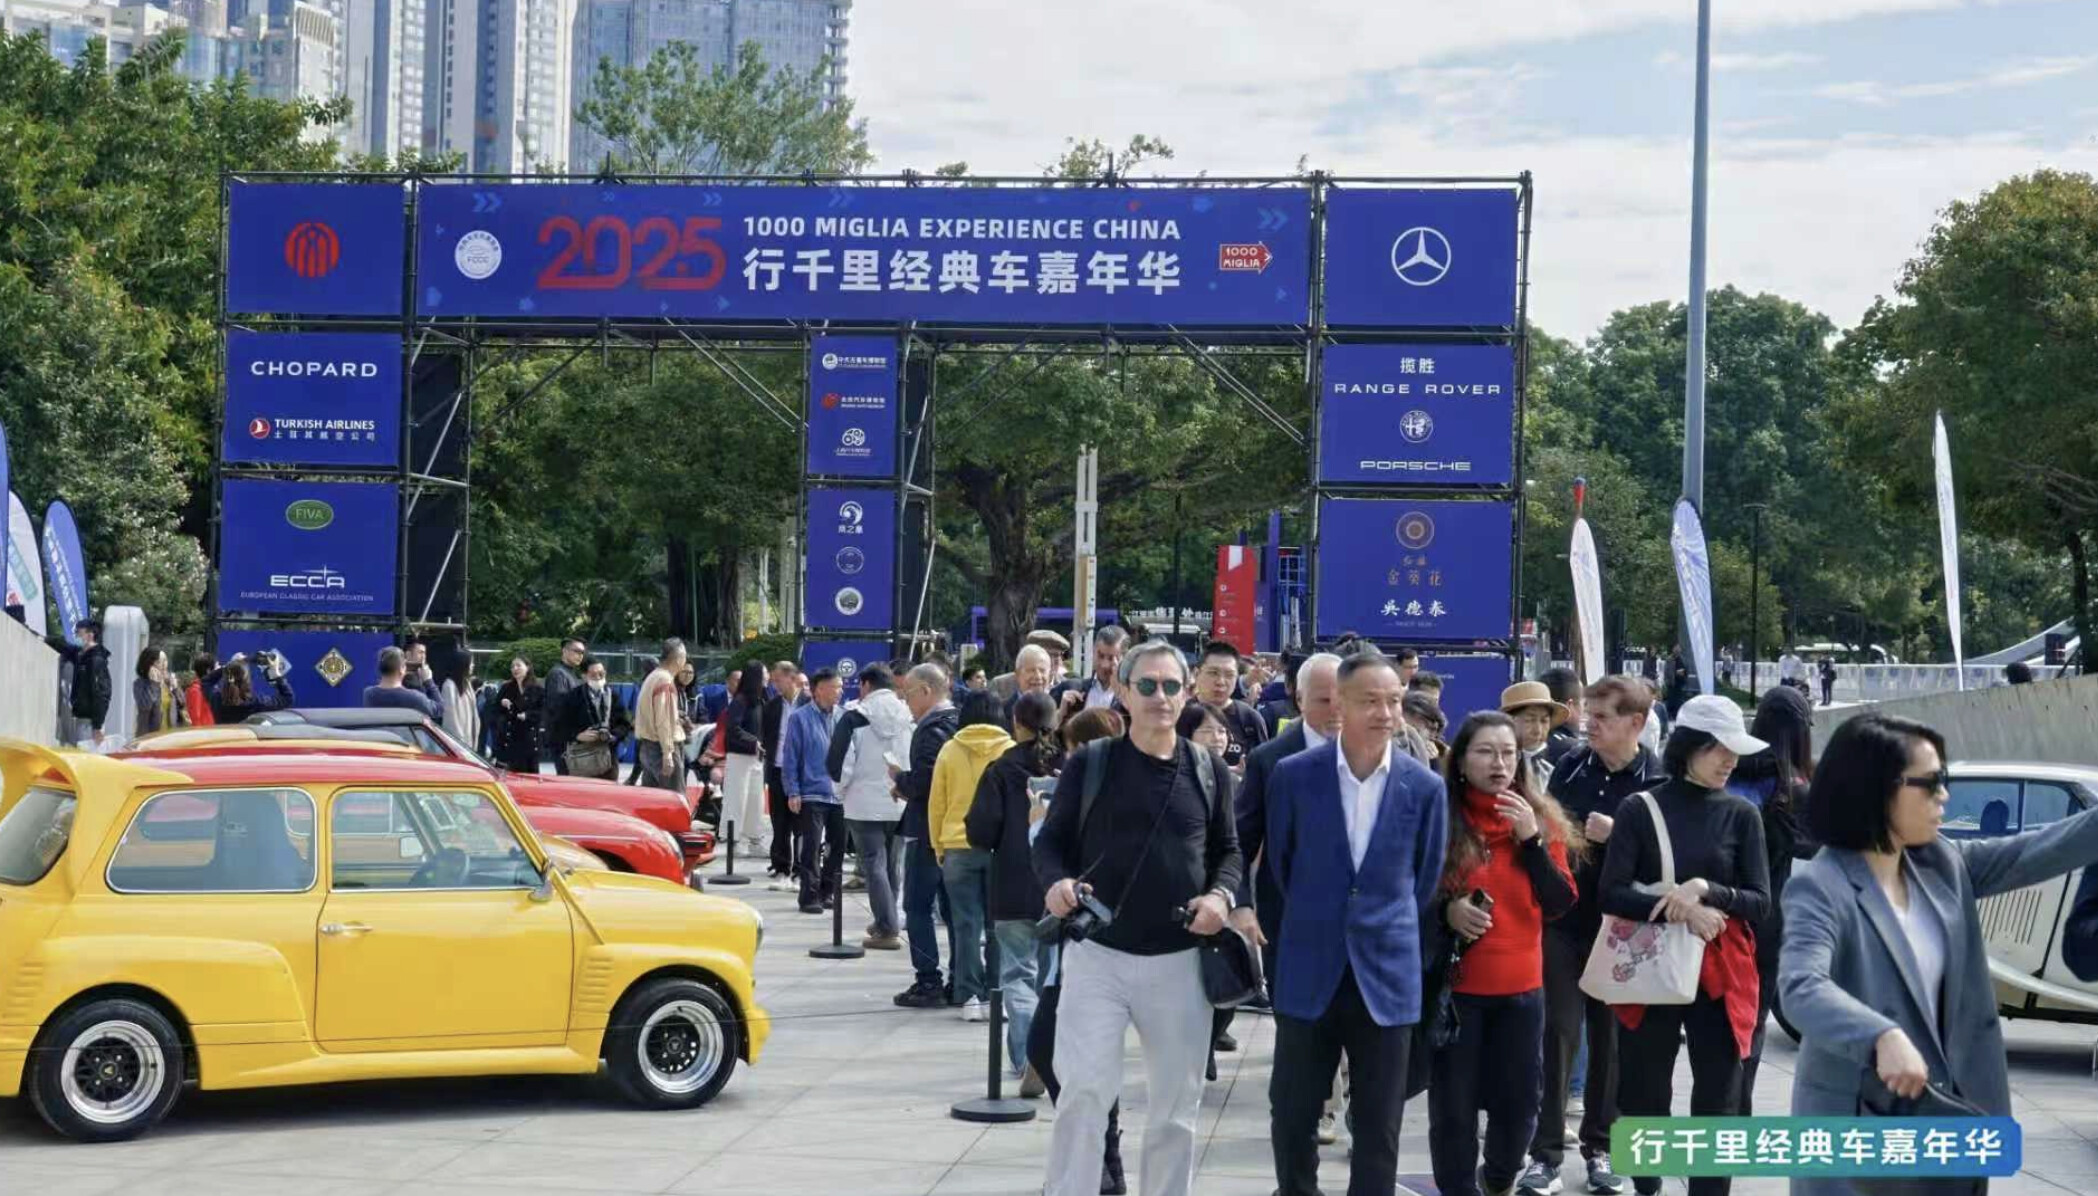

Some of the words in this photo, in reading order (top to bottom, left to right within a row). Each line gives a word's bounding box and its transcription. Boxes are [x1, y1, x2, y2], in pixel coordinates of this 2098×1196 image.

[743, 216, 805, 237] 1000
[815, 216, 909, 239] MIGLIA
[919, 217, 1083, 240] EXPERIENCE
[1093, 218, 1181, 240] CHINA
[538, 215, 726, 290] 2025
[1226, 247, 1258, 256] 1000
[1223, 258, 1260, 268] MIGLIA
[743, 247, 1181, 295] 行千里经典车嘉年华
[250, 361, 378, 377] CHOPARD
[1400, 357, 1435, 374] 揽胜
[1334, 383, 1410, 394] RANGE
[1425, 384, 1501, 394] ROVER
[274, 418, 323, 430] TURKISH
[325, 419, 375, 431] AIRLINES
[1360, 461, 1471, 471] PORSCHE
[295, 508, 324, 520] FIVA
[270, 574, 345, 588] ECCA
